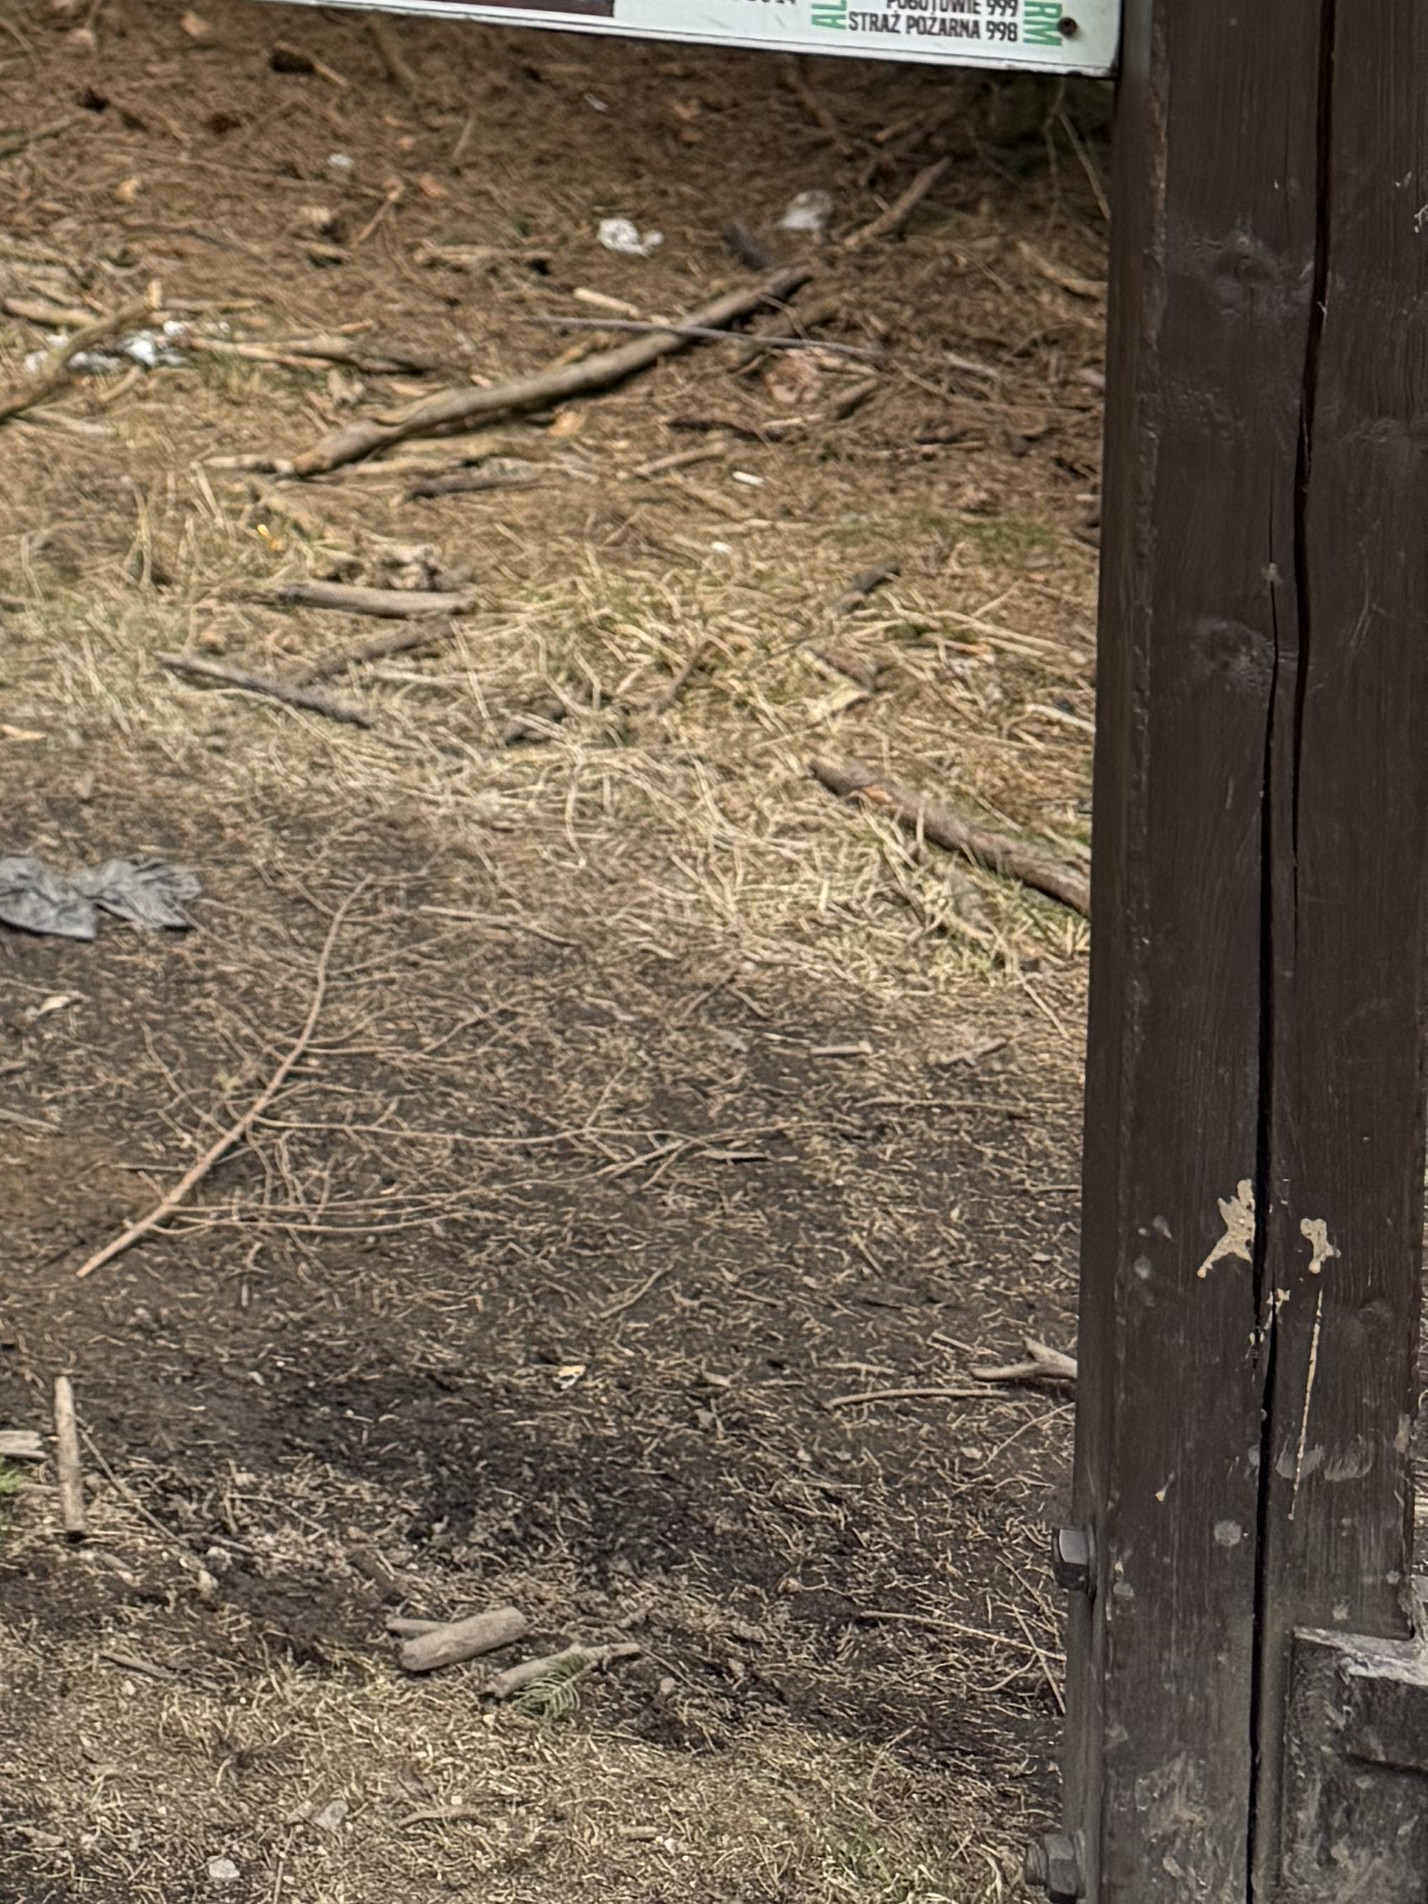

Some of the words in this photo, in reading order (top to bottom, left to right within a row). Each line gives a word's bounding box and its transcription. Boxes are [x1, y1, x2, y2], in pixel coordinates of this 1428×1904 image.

[850, 9, 900, 35] STRAŻ
[906, 12, 980, 39] POŻARNA
[986, 21, 1018, 42] 998
